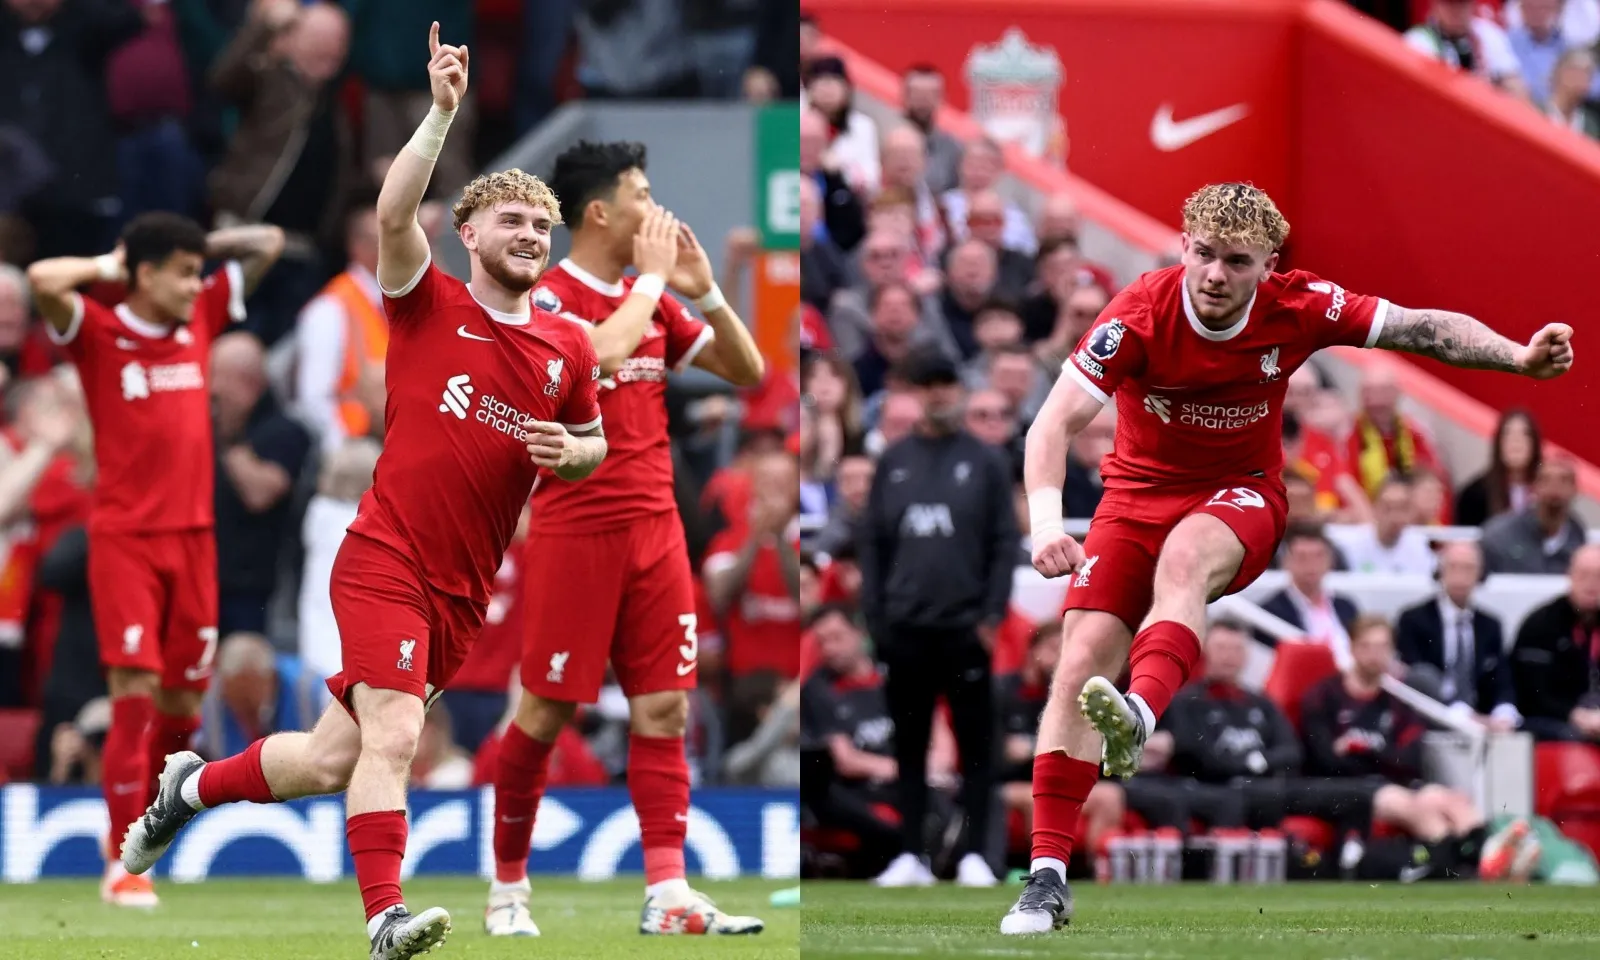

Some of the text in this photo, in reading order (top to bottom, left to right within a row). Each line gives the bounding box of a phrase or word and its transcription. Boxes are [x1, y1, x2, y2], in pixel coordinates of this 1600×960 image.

[476, 409, 528, 442] charte
[1205, 487, 1265, 508] 19
[197, 627, 219, 668] 7
[678, 613, 698, 661] 3
